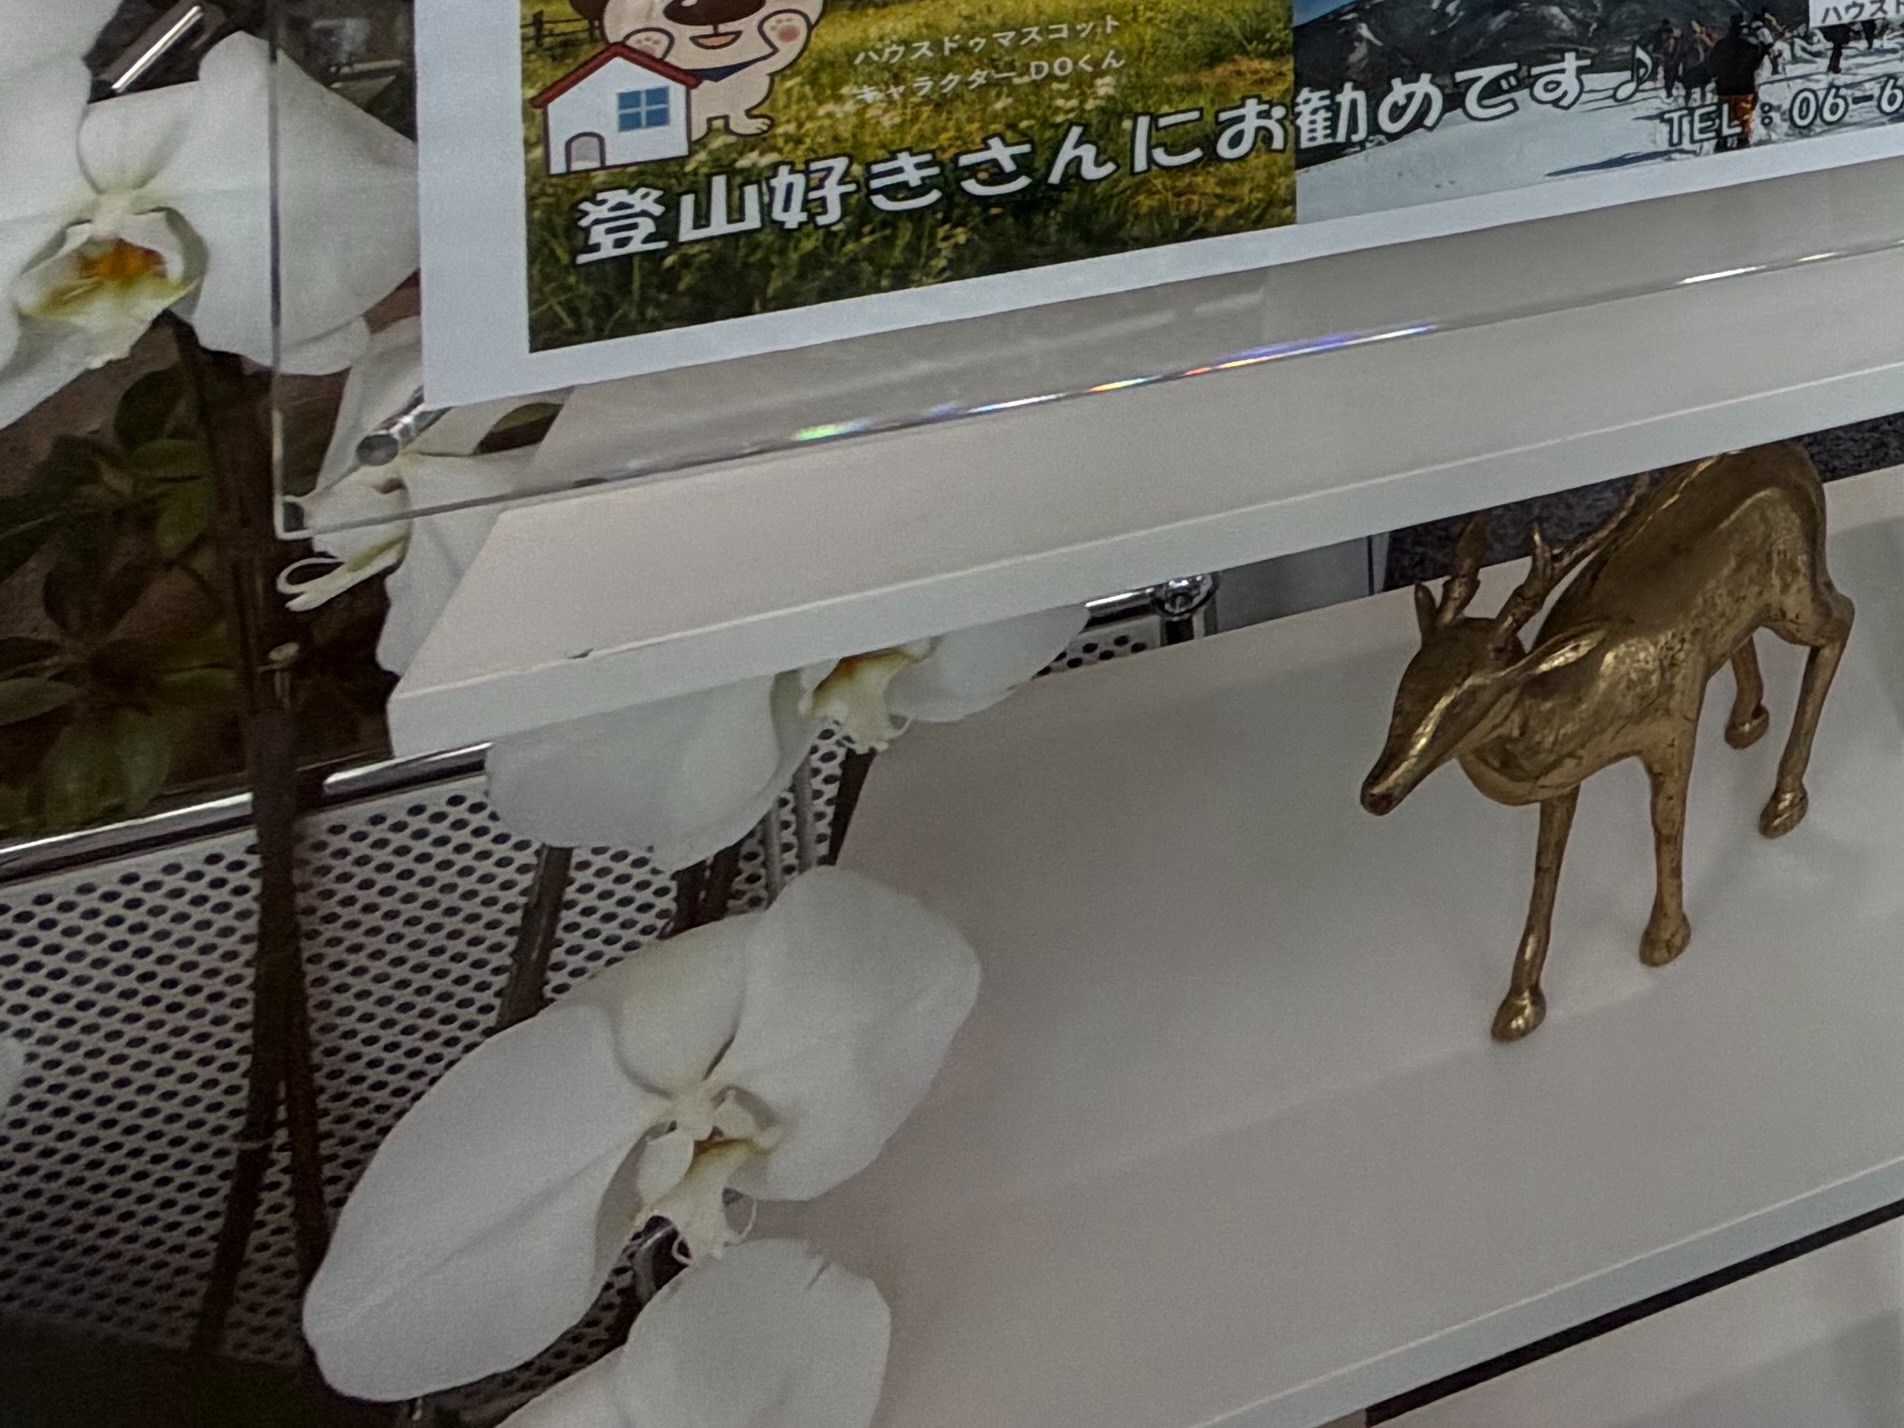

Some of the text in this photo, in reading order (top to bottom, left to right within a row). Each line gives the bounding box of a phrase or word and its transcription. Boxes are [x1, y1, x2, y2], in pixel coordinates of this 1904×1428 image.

[573, 47, 1592, 268] 登山好きさんにお勧めです
